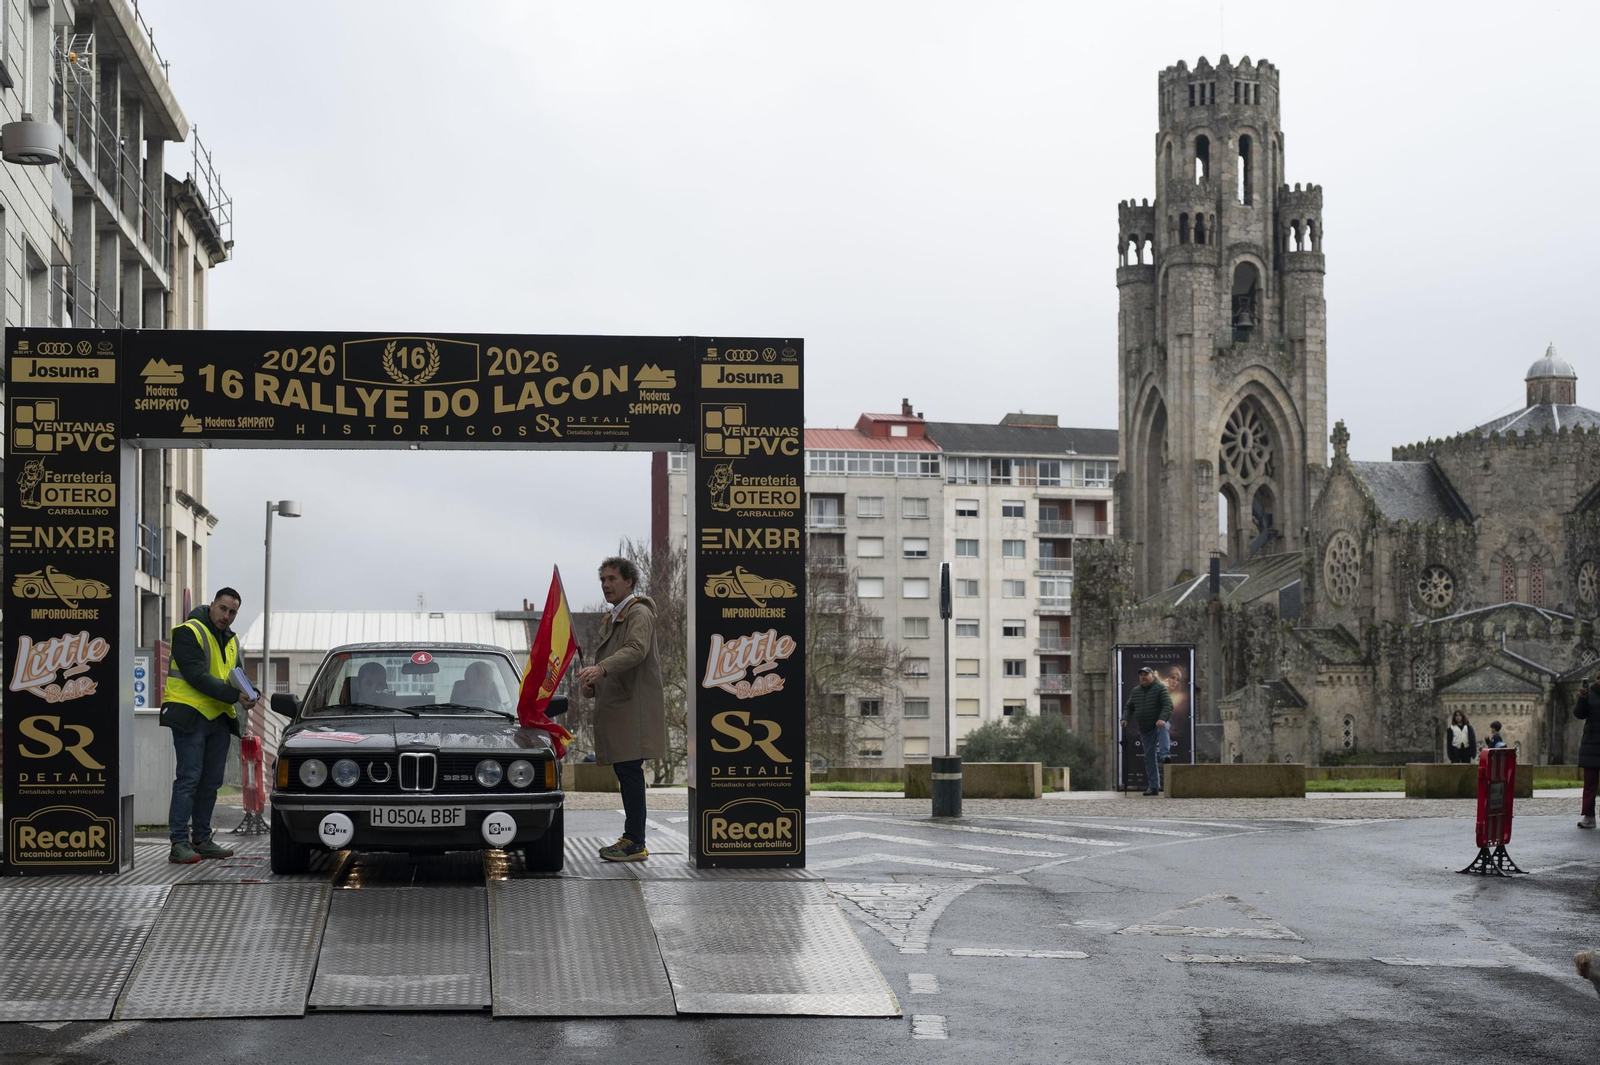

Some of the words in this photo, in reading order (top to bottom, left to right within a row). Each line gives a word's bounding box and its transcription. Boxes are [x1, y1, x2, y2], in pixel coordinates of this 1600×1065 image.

[262, 344, 336, 376] 2026
[396, 346, 426, 369] 16
[487, 347, 559, 376] 2026
[29, 360, 99, 378] Josuma
[717, 366, 784, 384] Josuma
[146, 385, 178, 397] Maderas
[199, 364, 244, 399] 16
[255, 372, 409, 419] RALLYE
[424, 388, 479, 419] DO
[494, 365, 628, 414] LACÓN
[639, 390, 670, 401] Maderas
[134, 398, 190, 411] SAMPAYO
[629, 403, 681, 415] SAMPAYO
[33, 421, 115, 433] VENTANAS
[205, 416, 236, 428] Maderas
[238, 416, 275, 429] SAMPAYO
[296, 424, 527, 436] HISTORICOS
[535, 413, 563, 437] SR
[722, 426, 799, 437] VENTANAS
[56, 432, 115, 452] PVC
[743, 437, 799, 456] PVC
[44, 471, 112, 483] Ferretería
[733, 474, 797, 486] Ferretería
[44, 488, 112, 503] OTERO
[733, 490, 797, 505] OTERO
[47, 507, 109, 516] CARBALLIÑO
[736, 509, 794, 517] CARBALLIÑO
[10, 526, 115, 548] ENXBR
[702, 528, 800, 549] ENXBR
[31, 608, 99, 620] IMPOROURENSE
[722, 607, 786, 618] IMPOROURENSE
[9, 630, 110, 692] Little
[417, 654, 427, 662] 4
[702, 628, 797, 689] Little
[45, 676, 98, 703] BAR
[735, 673, 786, 699] BAR
[18, 715, 106, 770] SR
[711, 711, 792, 763] SR
[19, 773, 107, 782] DETAIL
[711, 766, 793, 775] DETAIL
[373, 809, 383, 824] H
[387, 809, 426, 824] 0504
[431, 808, 462, 824] BBF
[712, 817, 792, 840] RecaR
[20, 825, 106, 849] RecaR
[712, 840, 752, 848] recambios
[753, 840, 792, 848] carballiño
[20, 849, 62, 858] recambios
[64, 849, 106, 858] carballiño
